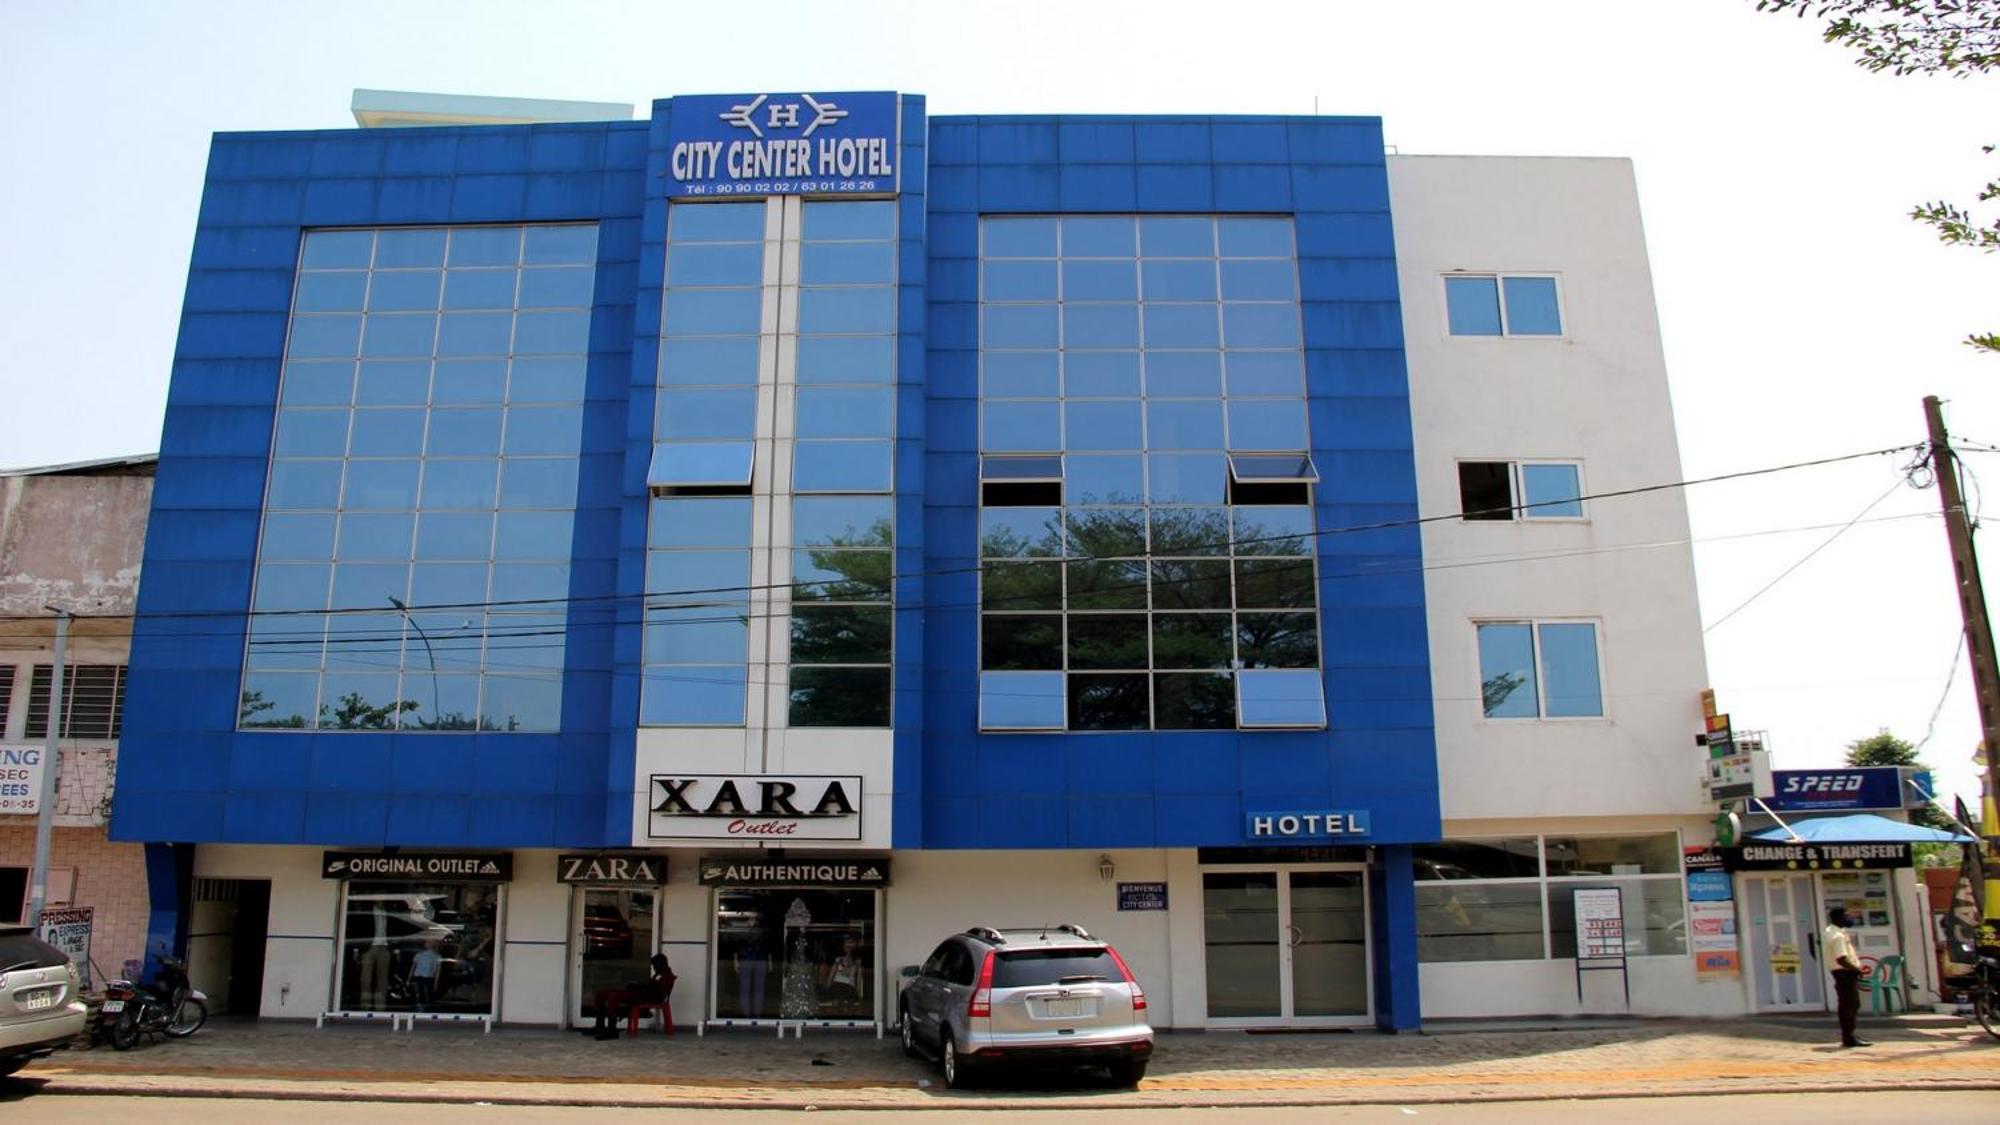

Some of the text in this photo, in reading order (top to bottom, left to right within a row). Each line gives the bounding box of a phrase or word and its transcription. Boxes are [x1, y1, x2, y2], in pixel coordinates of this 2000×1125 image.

[767, 104, 799, 128] H
[672, 137, 892, 181] CITY CENTER HOTEL
[716, 184, 732, 193] 90
[736, 183, 751, 193] 90
[755, 183, 770, 192] 02
[774, 183, 790, 192] 02
[801, 182, 817, 191] 63
[820, 182, 835, 191] 01
[840, 181, 856, 190] 26
[859, 181, 875, 190] 26
[0, 784, 30, 796] EES
[1784, 775, 1864, 792] SPEED
[651, 779, 858, 815] XARA
[727, 819, 797, 834] Outlet
[1254, 814, 1365, 836] HOTEL
[1743, 845, 1905, 860] CHANGE & TRANSFERT
[350, 859, 423, 873] ORIGINAL
[427, 859, 480, 873] OUTLET
[564, 858, 656, 881] ZARA
[724, 865, 858, 881] AUTHENTIQUE
[1121, 884, 1163, 893] BIENVENUE
[41, 909, 92, 926] PRESSING
[59, 925, 89, 937] EXPRESS
